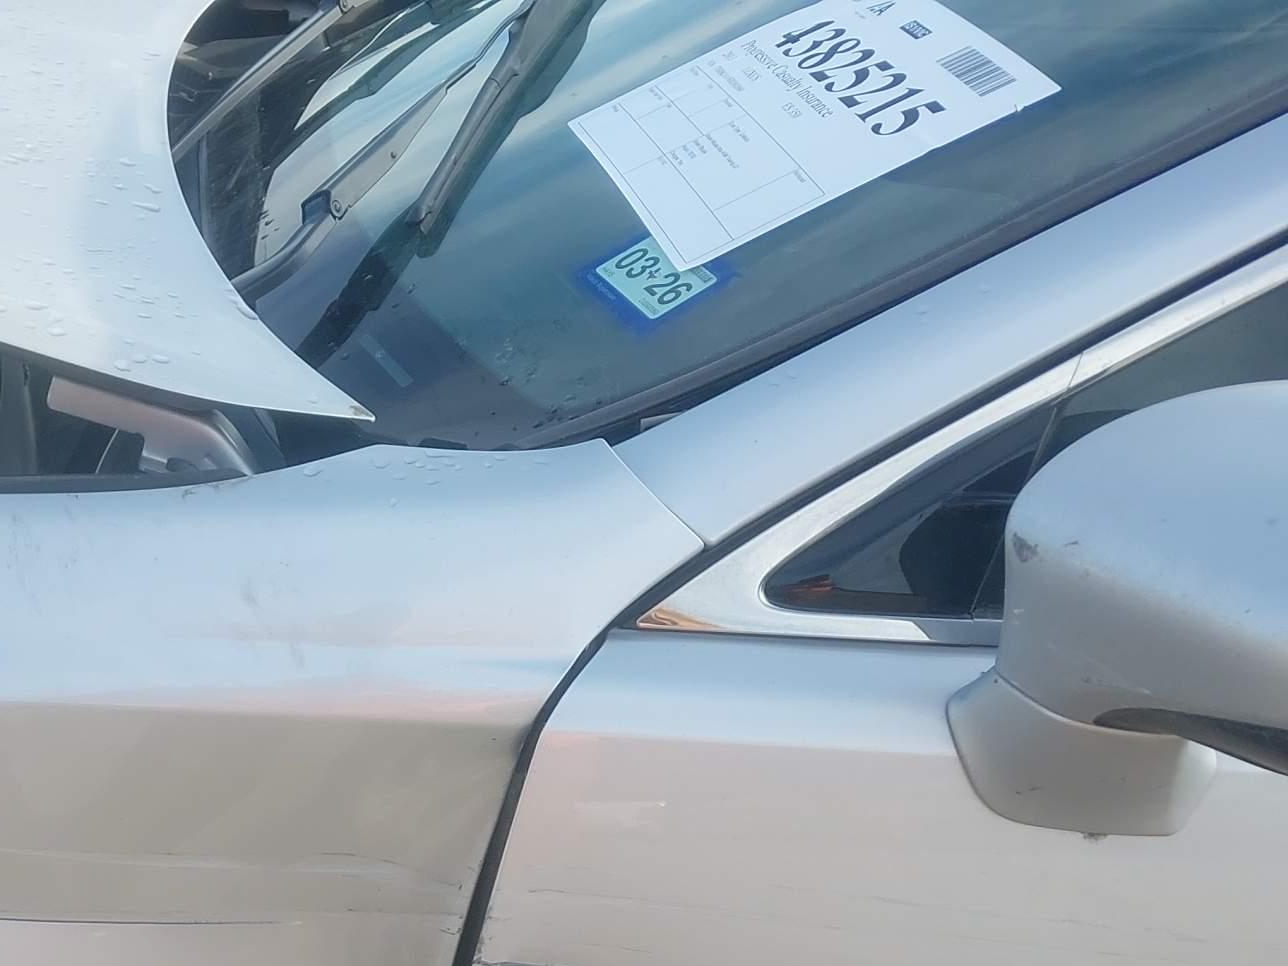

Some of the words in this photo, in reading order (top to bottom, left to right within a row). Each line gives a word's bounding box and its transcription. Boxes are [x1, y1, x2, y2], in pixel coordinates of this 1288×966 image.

[741, 39, 779, 74] Progressive
[775, 65, 803, 92] Casualty
[796, 85, 833, 118] Insurance
[775, 20, 947, 136] 43825215
[615, 248, 660, 278] 03
[643, 272, 693, 305] 26
